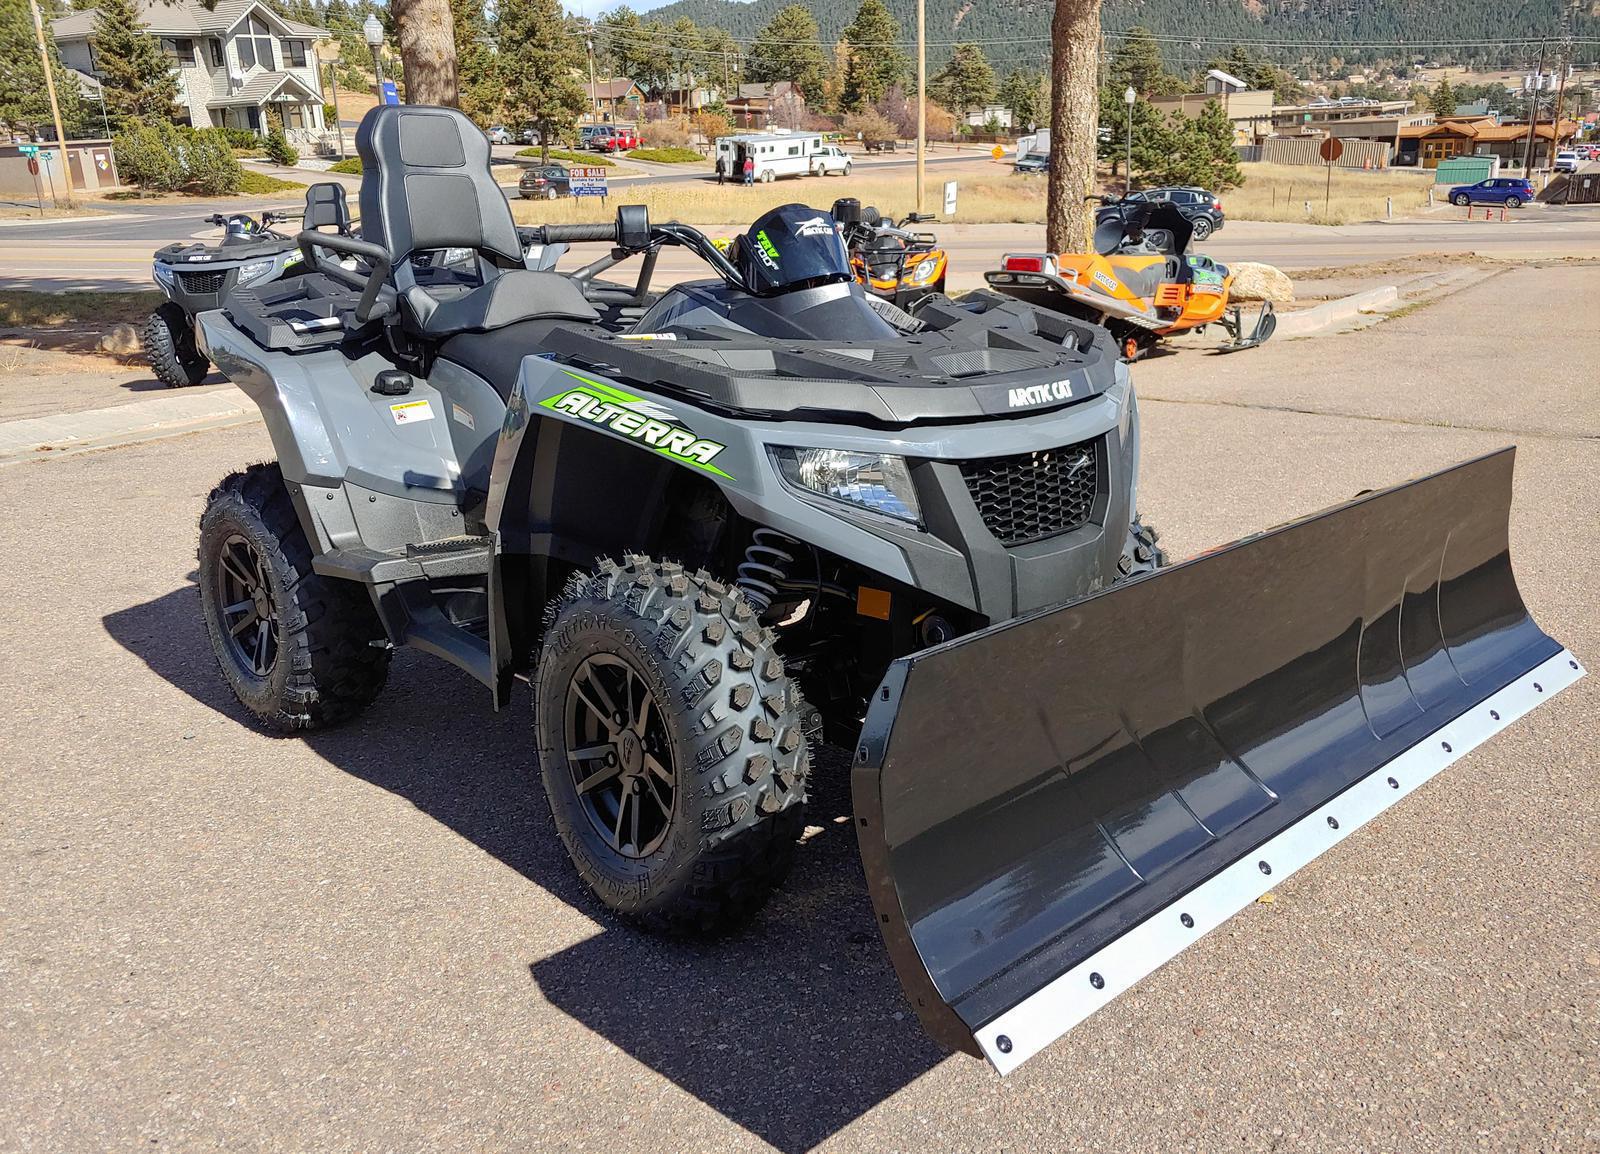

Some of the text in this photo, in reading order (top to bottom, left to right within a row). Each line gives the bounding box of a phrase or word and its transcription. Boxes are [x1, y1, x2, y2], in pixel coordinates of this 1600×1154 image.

[570, 168, 605, 177] FOR SALE
[754, 241, 772, 266] 700
[756, 230, 779, 257] TRV
[1008, 380, 1073, 407] ARCTIC CAT
[554, 391, 728, 465] ALTERRA
